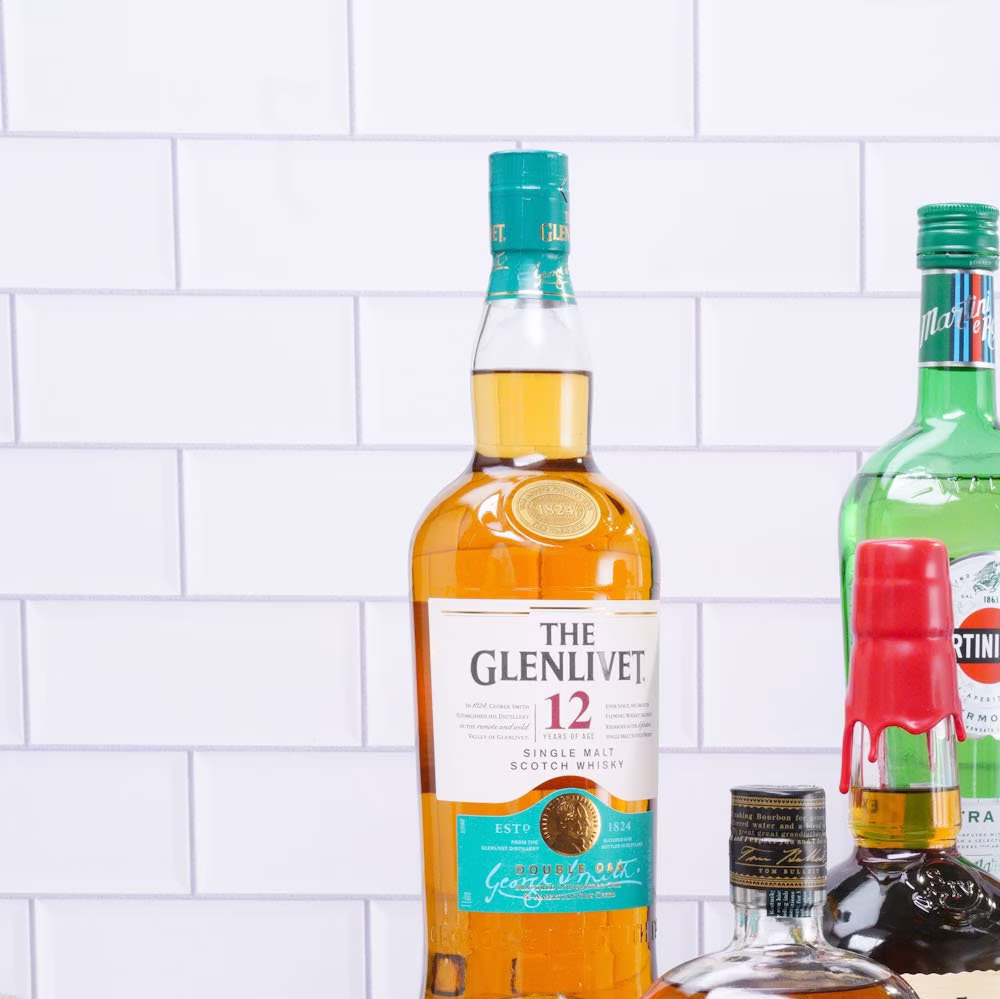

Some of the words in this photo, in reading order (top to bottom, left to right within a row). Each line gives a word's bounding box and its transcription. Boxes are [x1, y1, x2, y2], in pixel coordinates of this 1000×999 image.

[540, 622, 595, 646] THE
[545, 690, 592, 730] 12
[543, 732, 567, 741] YEARS
[570, 732, 580, 741] OF
[581, 732, 595, 741] AGE
[523, 748, 576, 758] SINGLE
[583, 747, 614, 757] MALT
[510, 761, 569, 771] SCOTCH
[576, 760, 624, 770] WHISKY
[756, 813, 791, 821] Bourbon
[608, 822, 632, 832] 1824
[516, 864, 586, 875] DOUBLE
